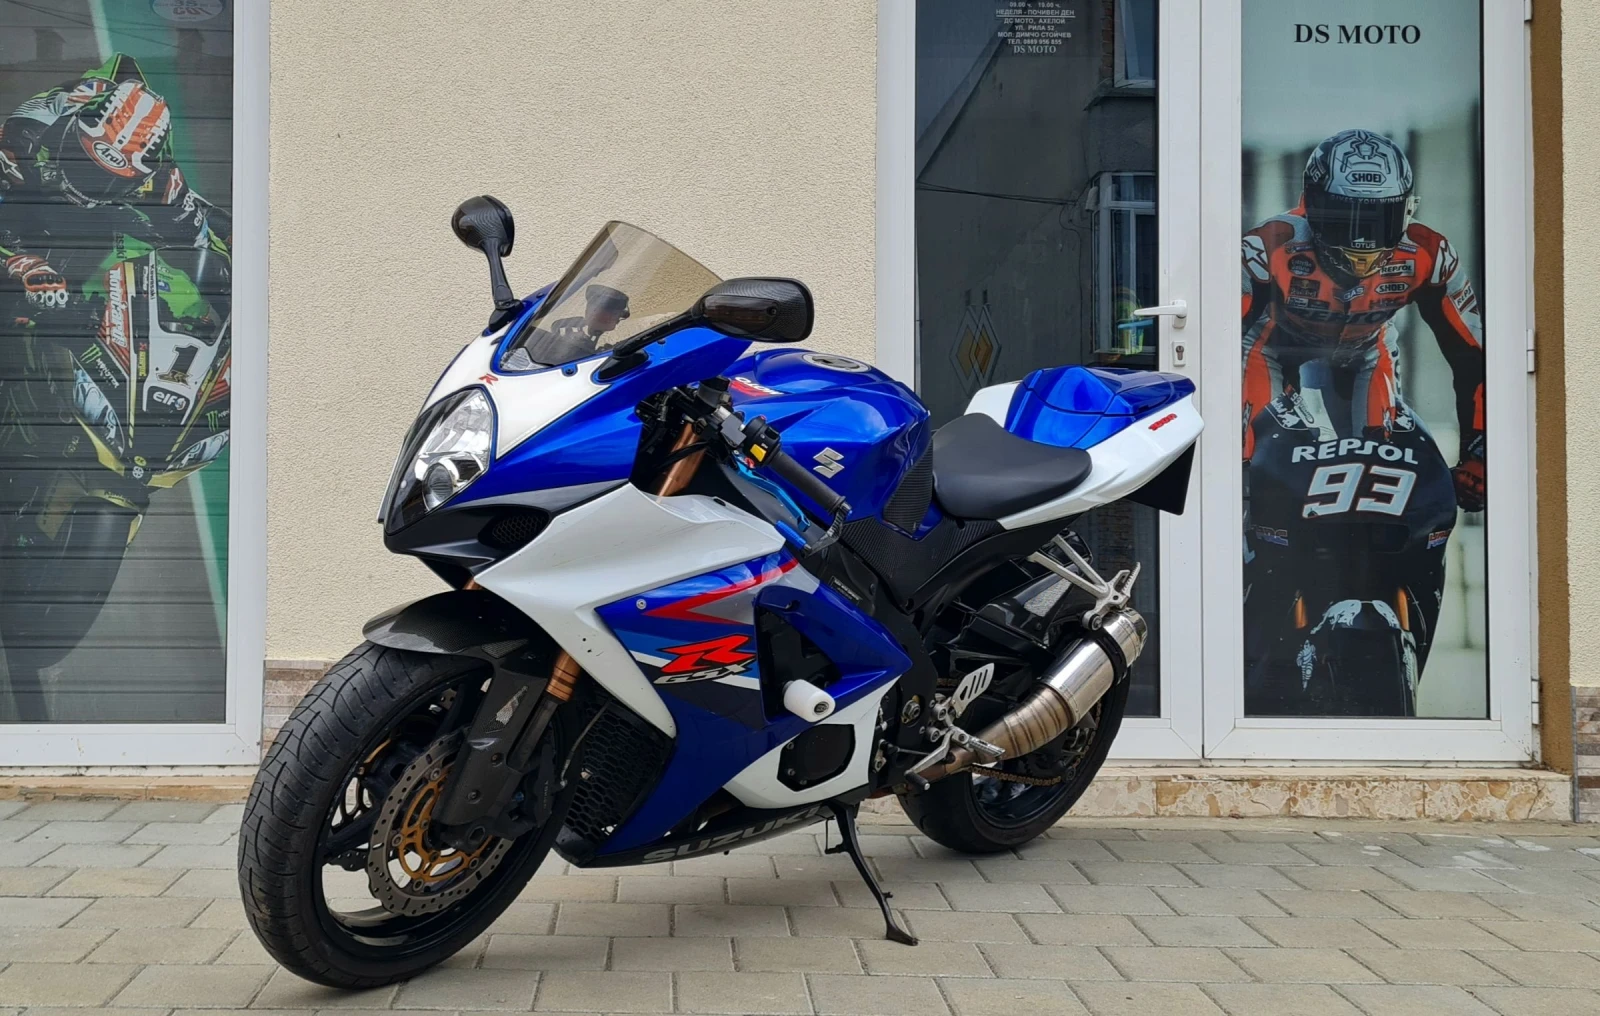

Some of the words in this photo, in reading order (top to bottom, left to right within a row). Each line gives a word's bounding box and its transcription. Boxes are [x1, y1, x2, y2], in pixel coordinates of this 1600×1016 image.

[1294, 23, 1330, 43] DS
[1337, 24, 1421, 44] MOTO
[1014, 45, 1026, 53] DS
[1027, 45, 1057, 53] MOTO
[1351, 172, 1382, 184] SHOEI
[1351, 241, 1377, 249] LOTUS
[1381, 263, 1413, 274] REPSOL
[1343, 286, 1365, 300] GAS
[1379, 282, 1406, 292] SHOEI
[1291, 438, 1419, 465] REPSOL
[1302, 462, 1417, 518] 93
[653, 658, 756, 685] GSX
[642, 805, 822, 864] SUZUKI
